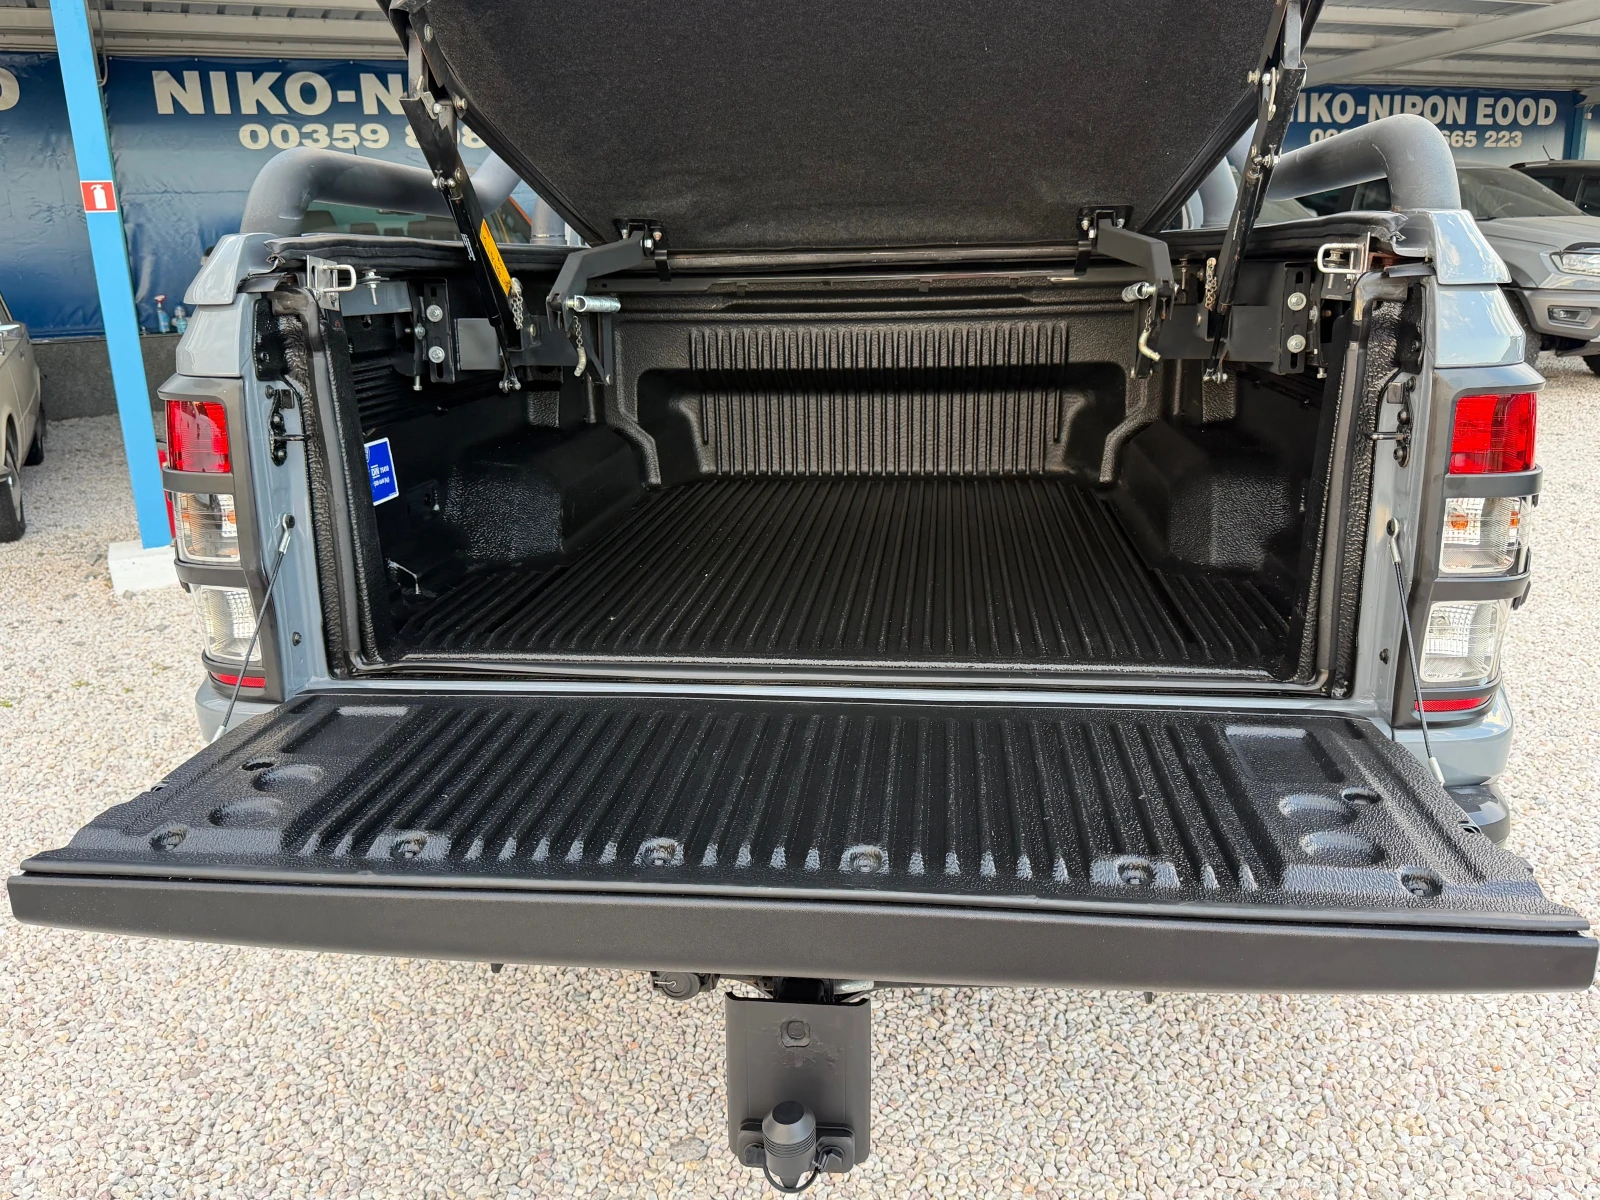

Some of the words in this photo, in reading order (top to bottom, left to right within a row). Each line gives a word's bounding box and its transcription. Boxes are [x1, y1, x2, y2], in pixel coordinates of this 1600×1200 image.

[1289, 92, 1467, 125] IKO-NIPON
[1476, 97, 1557, 126] EOOD
[239, 123, 390, 149] 00359
[1484, 131, 1523, 148] 223
